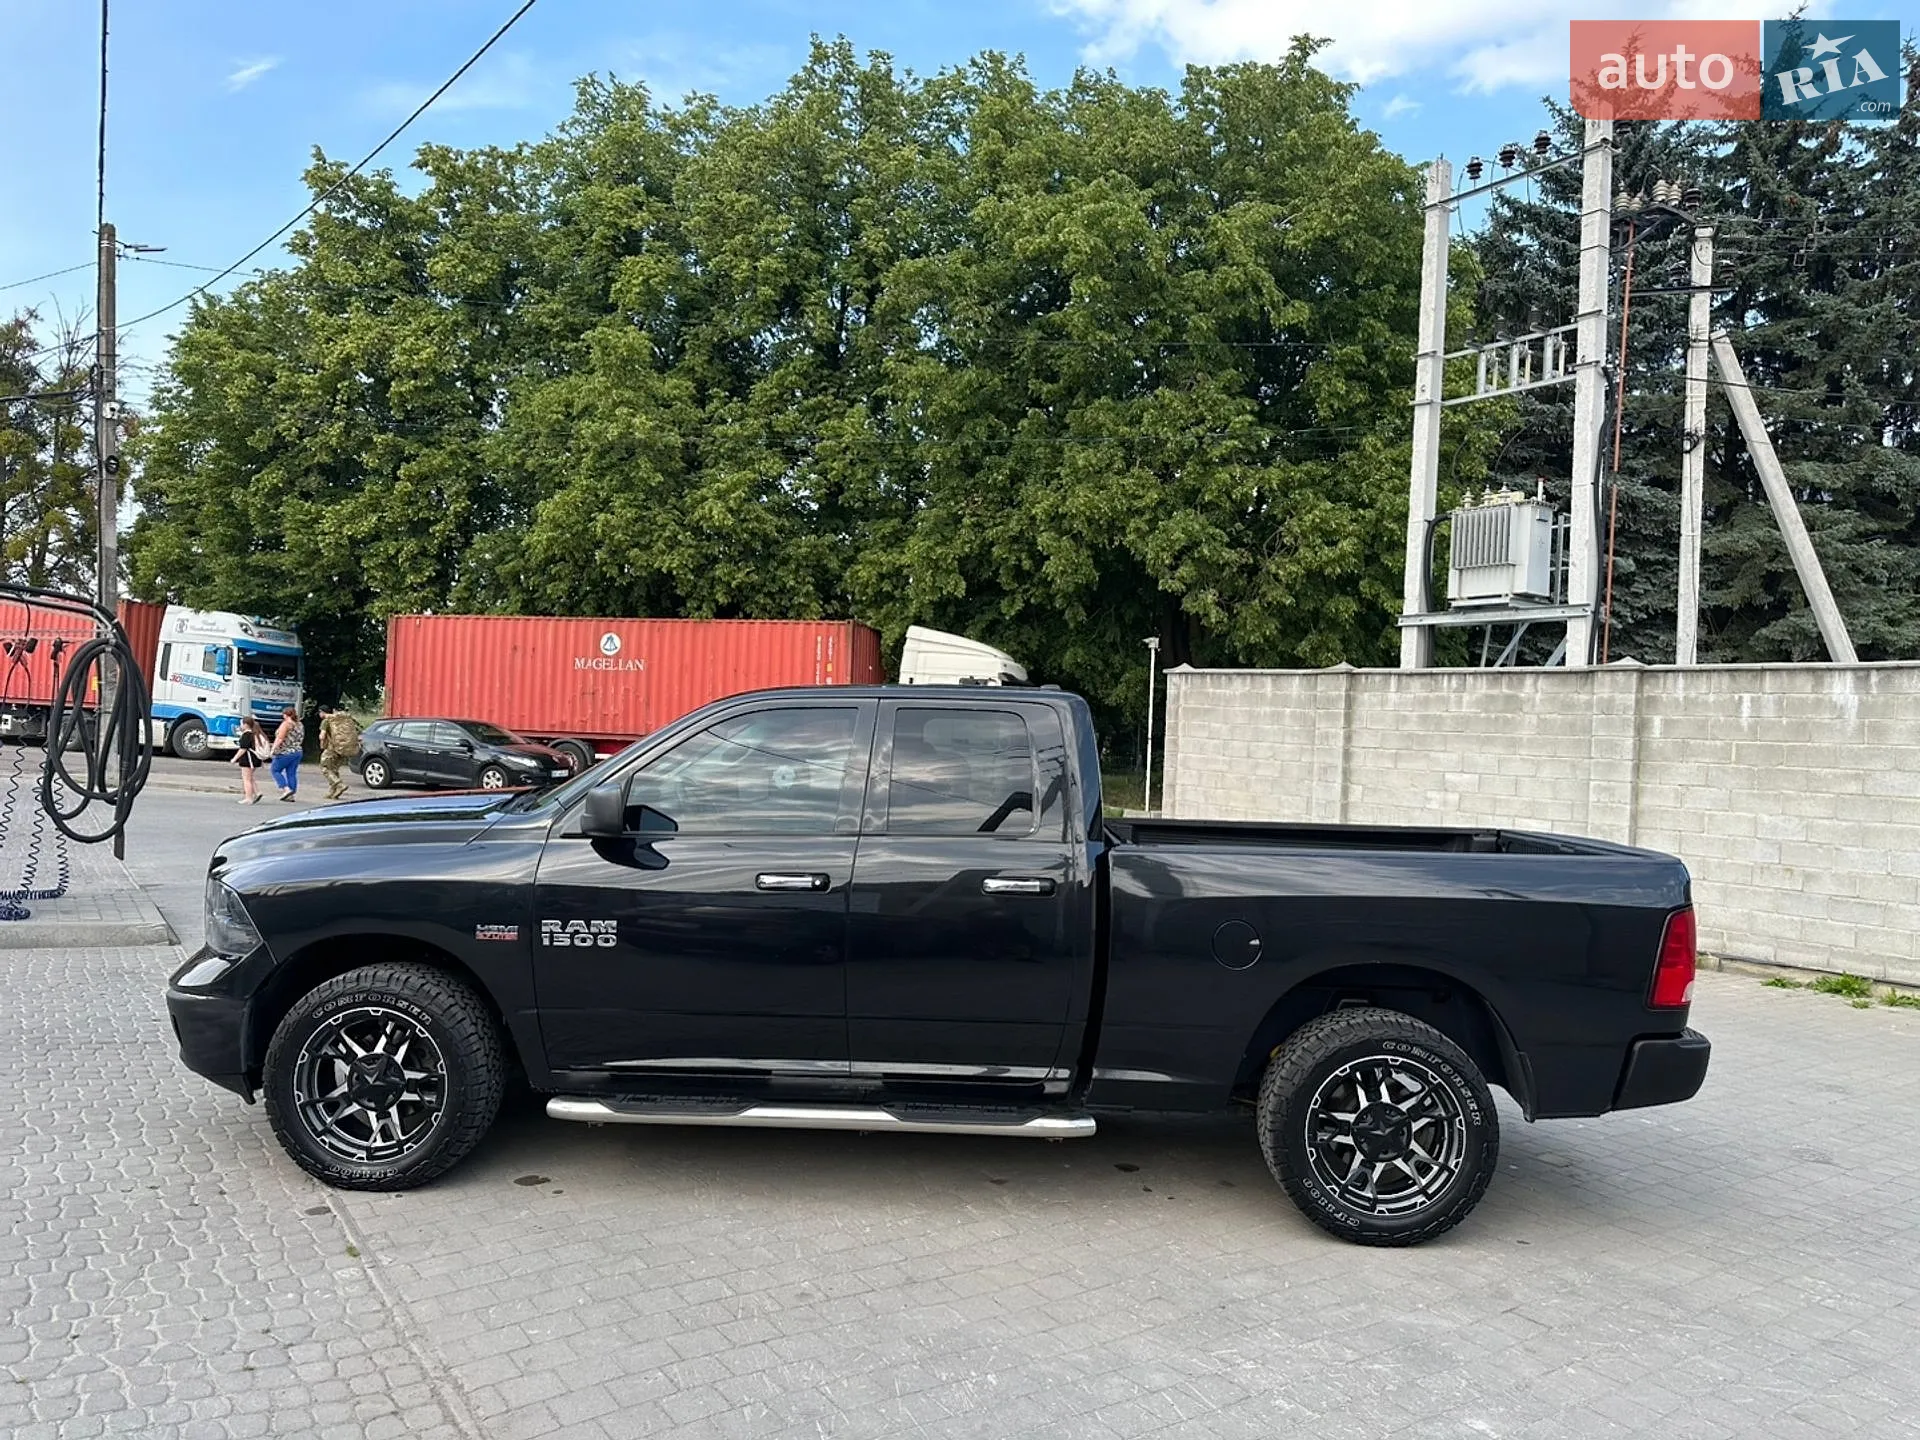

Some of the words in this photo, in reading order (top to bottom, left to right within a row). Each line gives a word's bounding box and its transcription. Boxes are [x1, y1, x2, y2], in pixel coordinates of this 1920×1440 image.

[574, 657, 645, 671] MAGELLAN
[541, 920, 617, 933] RAM
[541, 933, 617, 947] 1500
